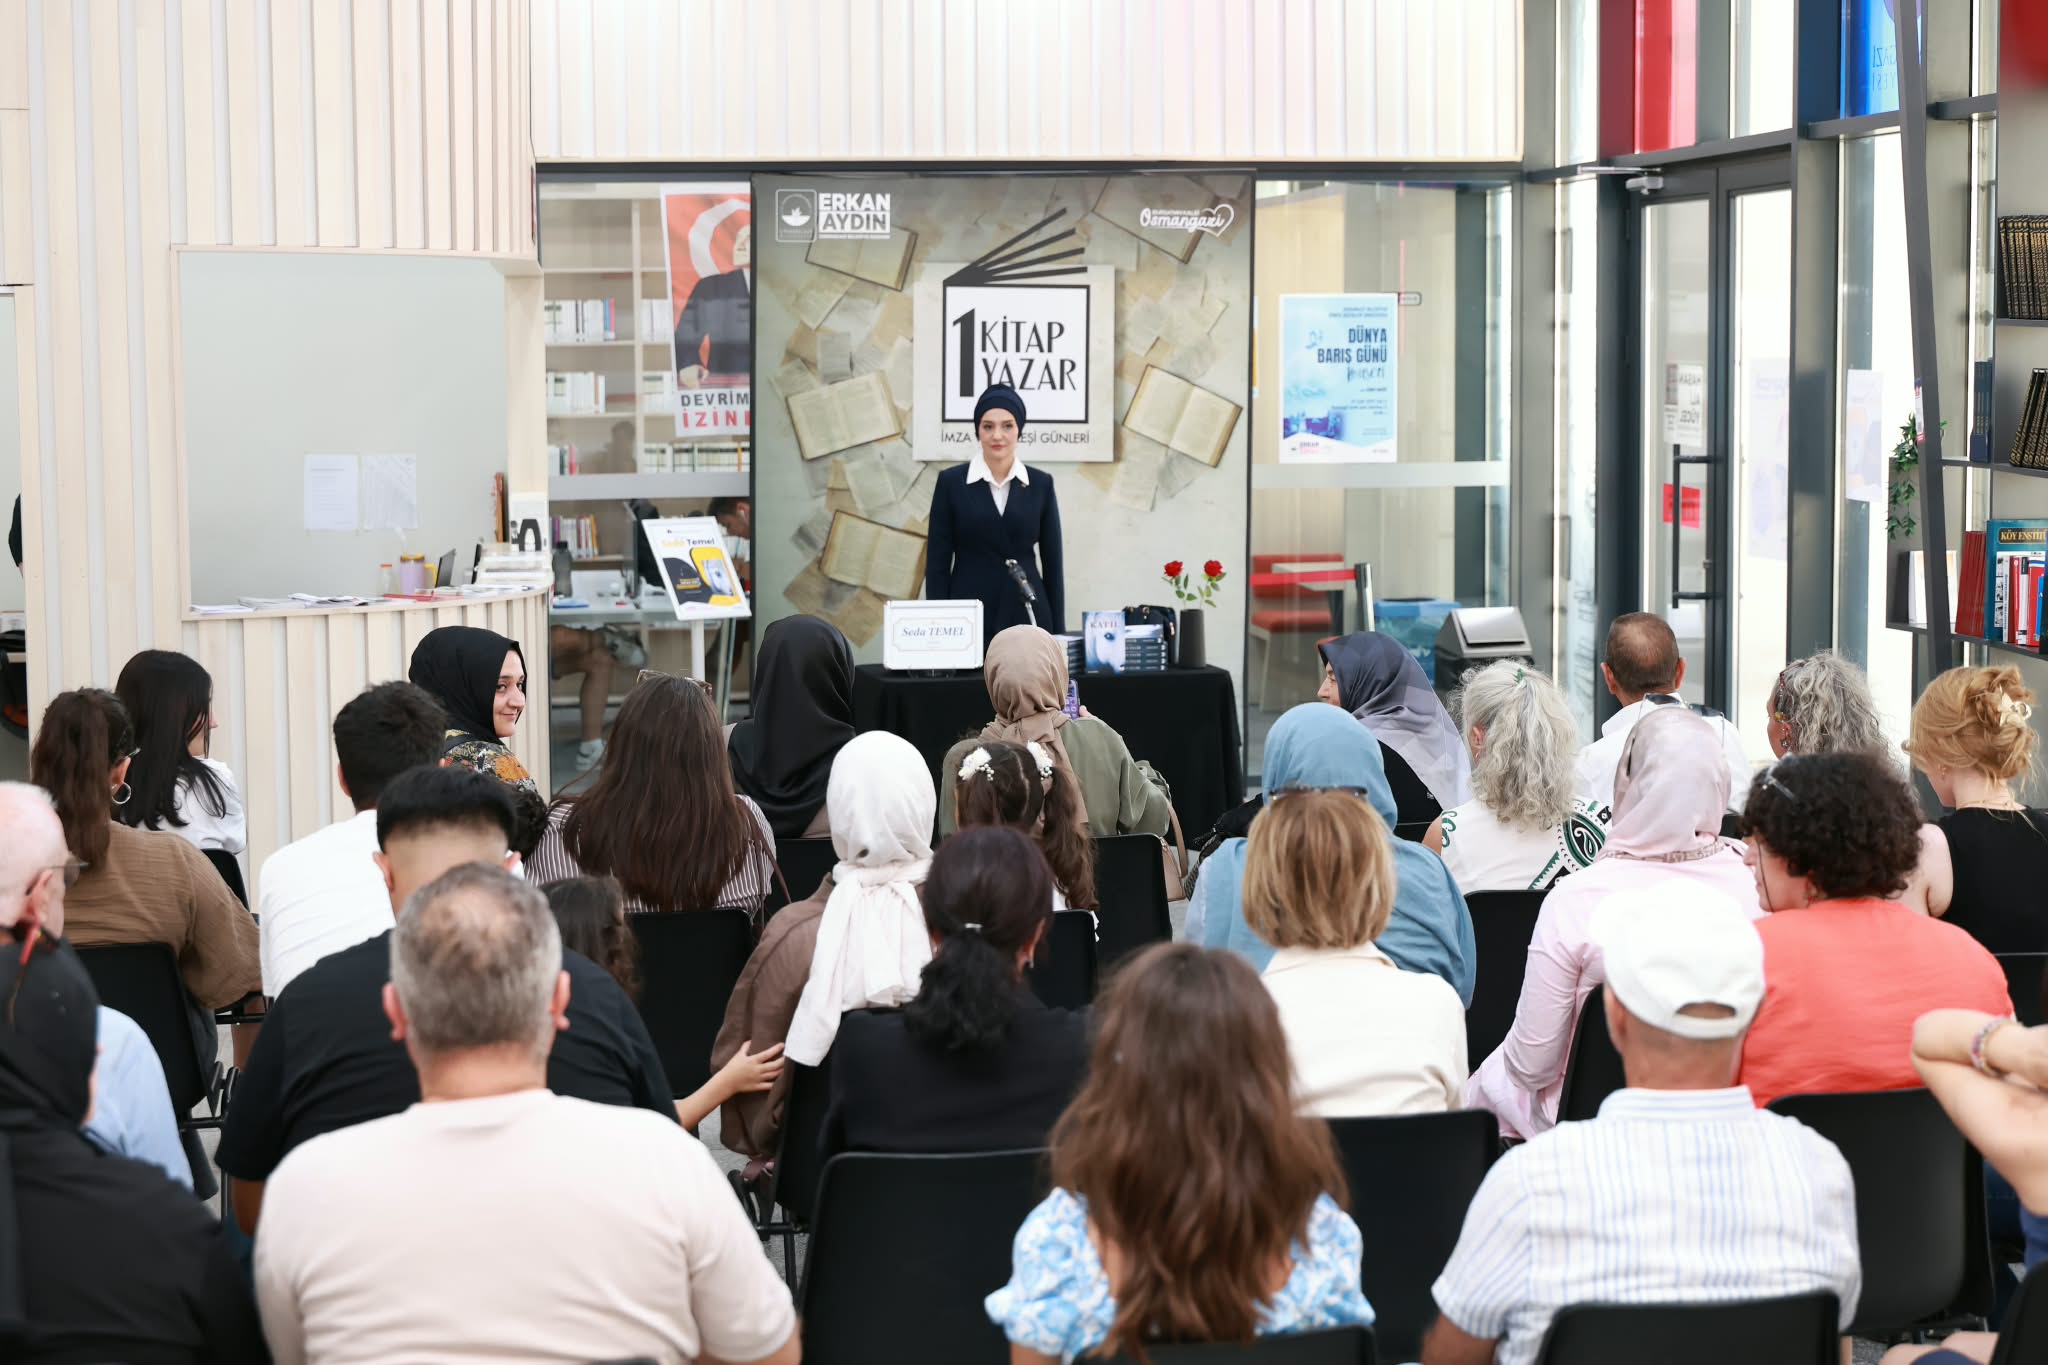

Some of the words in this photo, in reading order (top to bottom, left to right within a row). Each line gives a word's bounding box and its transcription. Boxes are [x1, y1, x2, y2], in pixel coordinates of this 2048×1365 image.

[819, 193, 891, 211] ERKAN
[822, 213, 887, 231] AYDIN
[1140, 208, 1225, 233] Osmangazi
[981, 316, 1065, 353] KİTAP
[1348, 324, 1387, 343] DÜNYA
[952, 308, 975, 397] 1
[1356, 344, 1387, 363] GÜNÜ
[981, 358, 1077, 391] YAZAR
[681, 390, 749, 407] DEVRİM
[941, 428, 972, 443] İMZA
[1040, 428, 1090, 444] GÜNLERİ
[687, 538, 715, 546] Temel
[2001, 529, 2018, 540] KÖY
[902, 626, 926, 637] Seda
[928, 626, 965, 637] TEMEL
